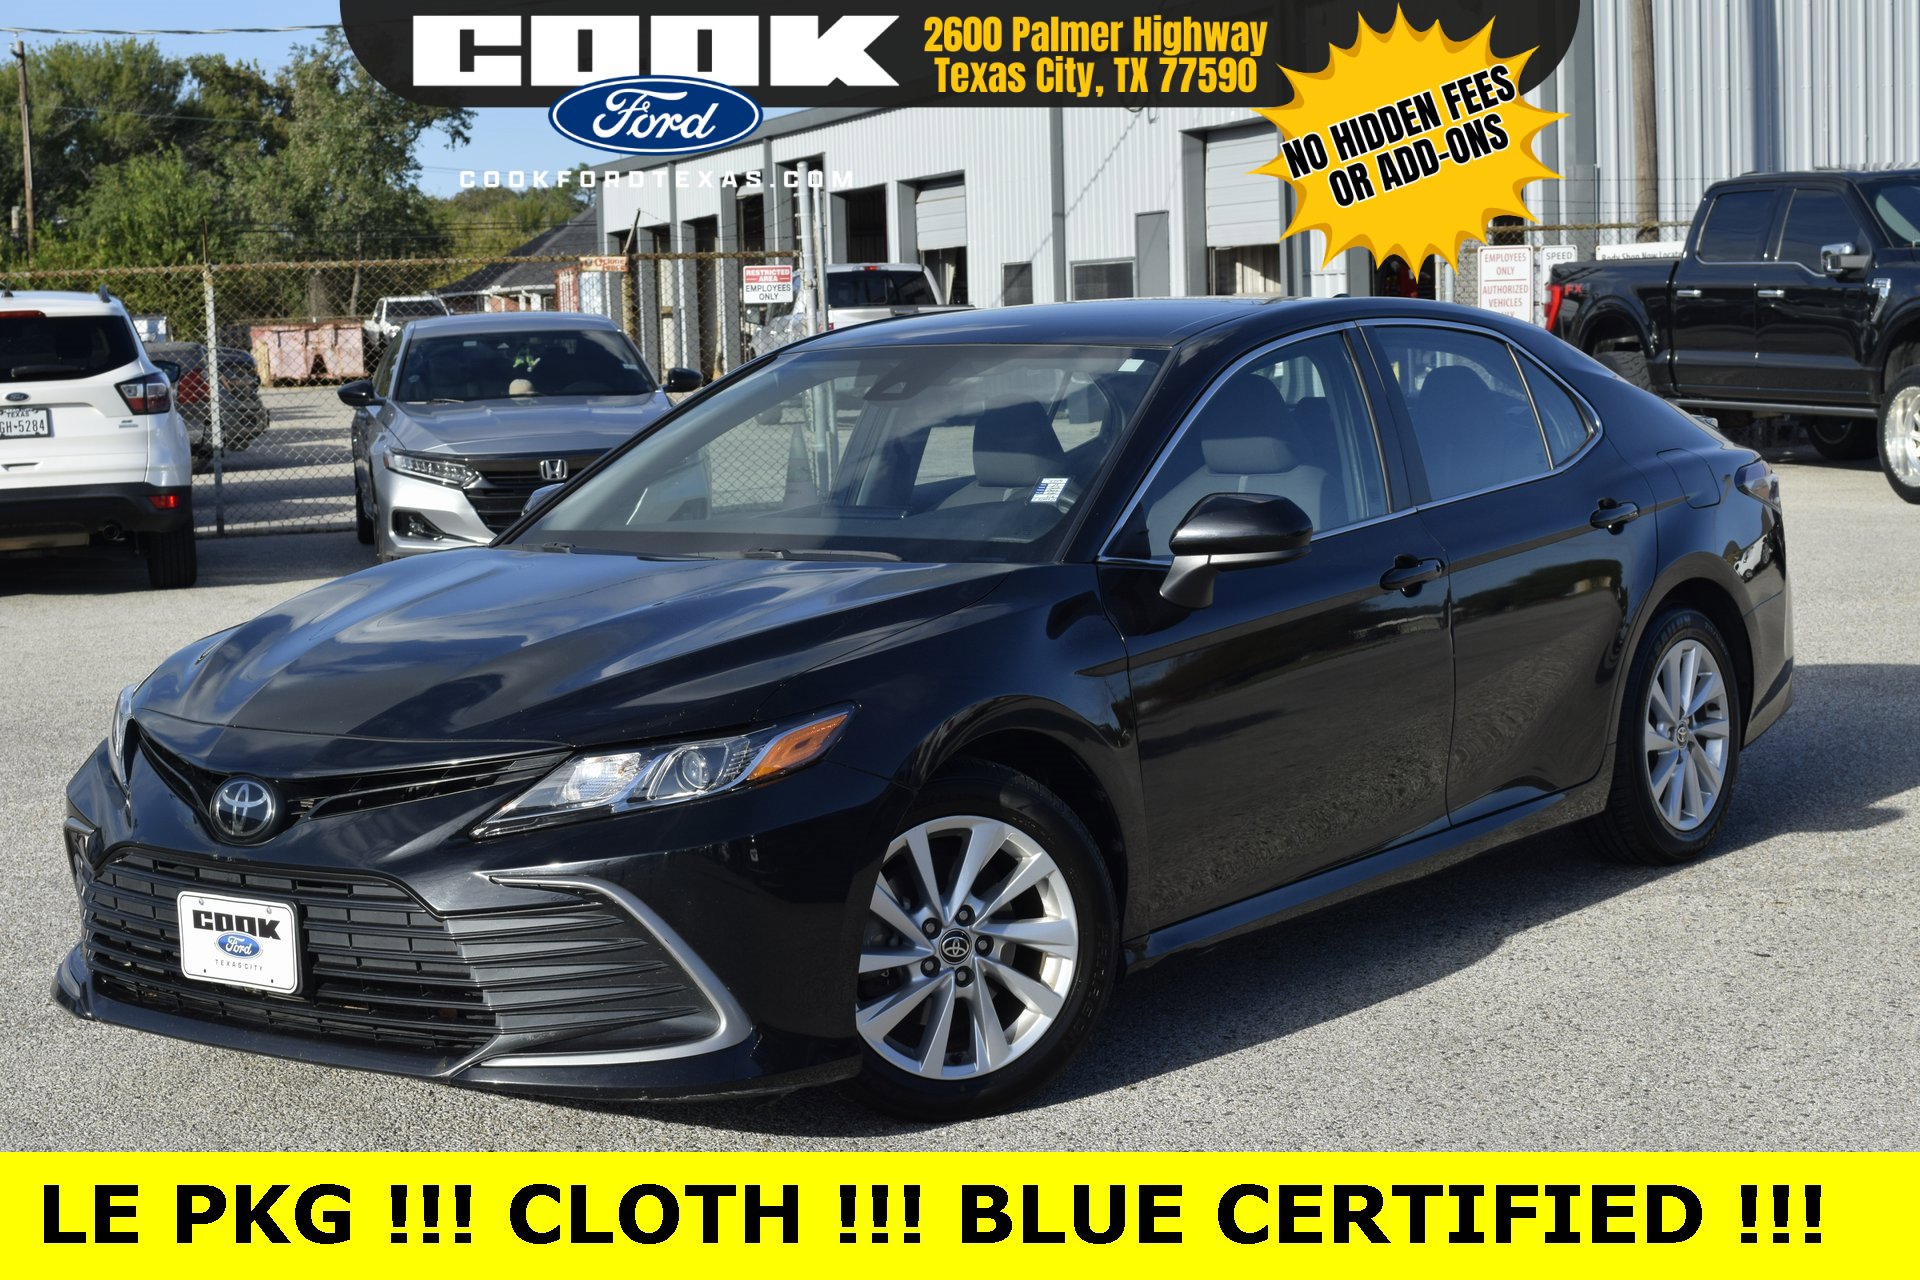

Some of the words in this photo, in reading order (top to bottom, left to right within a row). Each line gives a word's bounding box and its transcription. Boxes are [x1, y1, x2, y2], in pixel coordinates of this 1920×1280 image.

[1484, 253, 1526, 262] EMPLOYEES
[1546, 252, 1573, 260] SPEED
[1496, 267, 1515, 275] ONLY
[745, 284, 791, 292] EMPLOYEES
[1482, 284, 1529, 294] AUTHORIZED
[1488, 298, 1522, 307] VEHICLES
[192, 909, 281, 940] COOK
[225, 936, 252, 955] Ford
